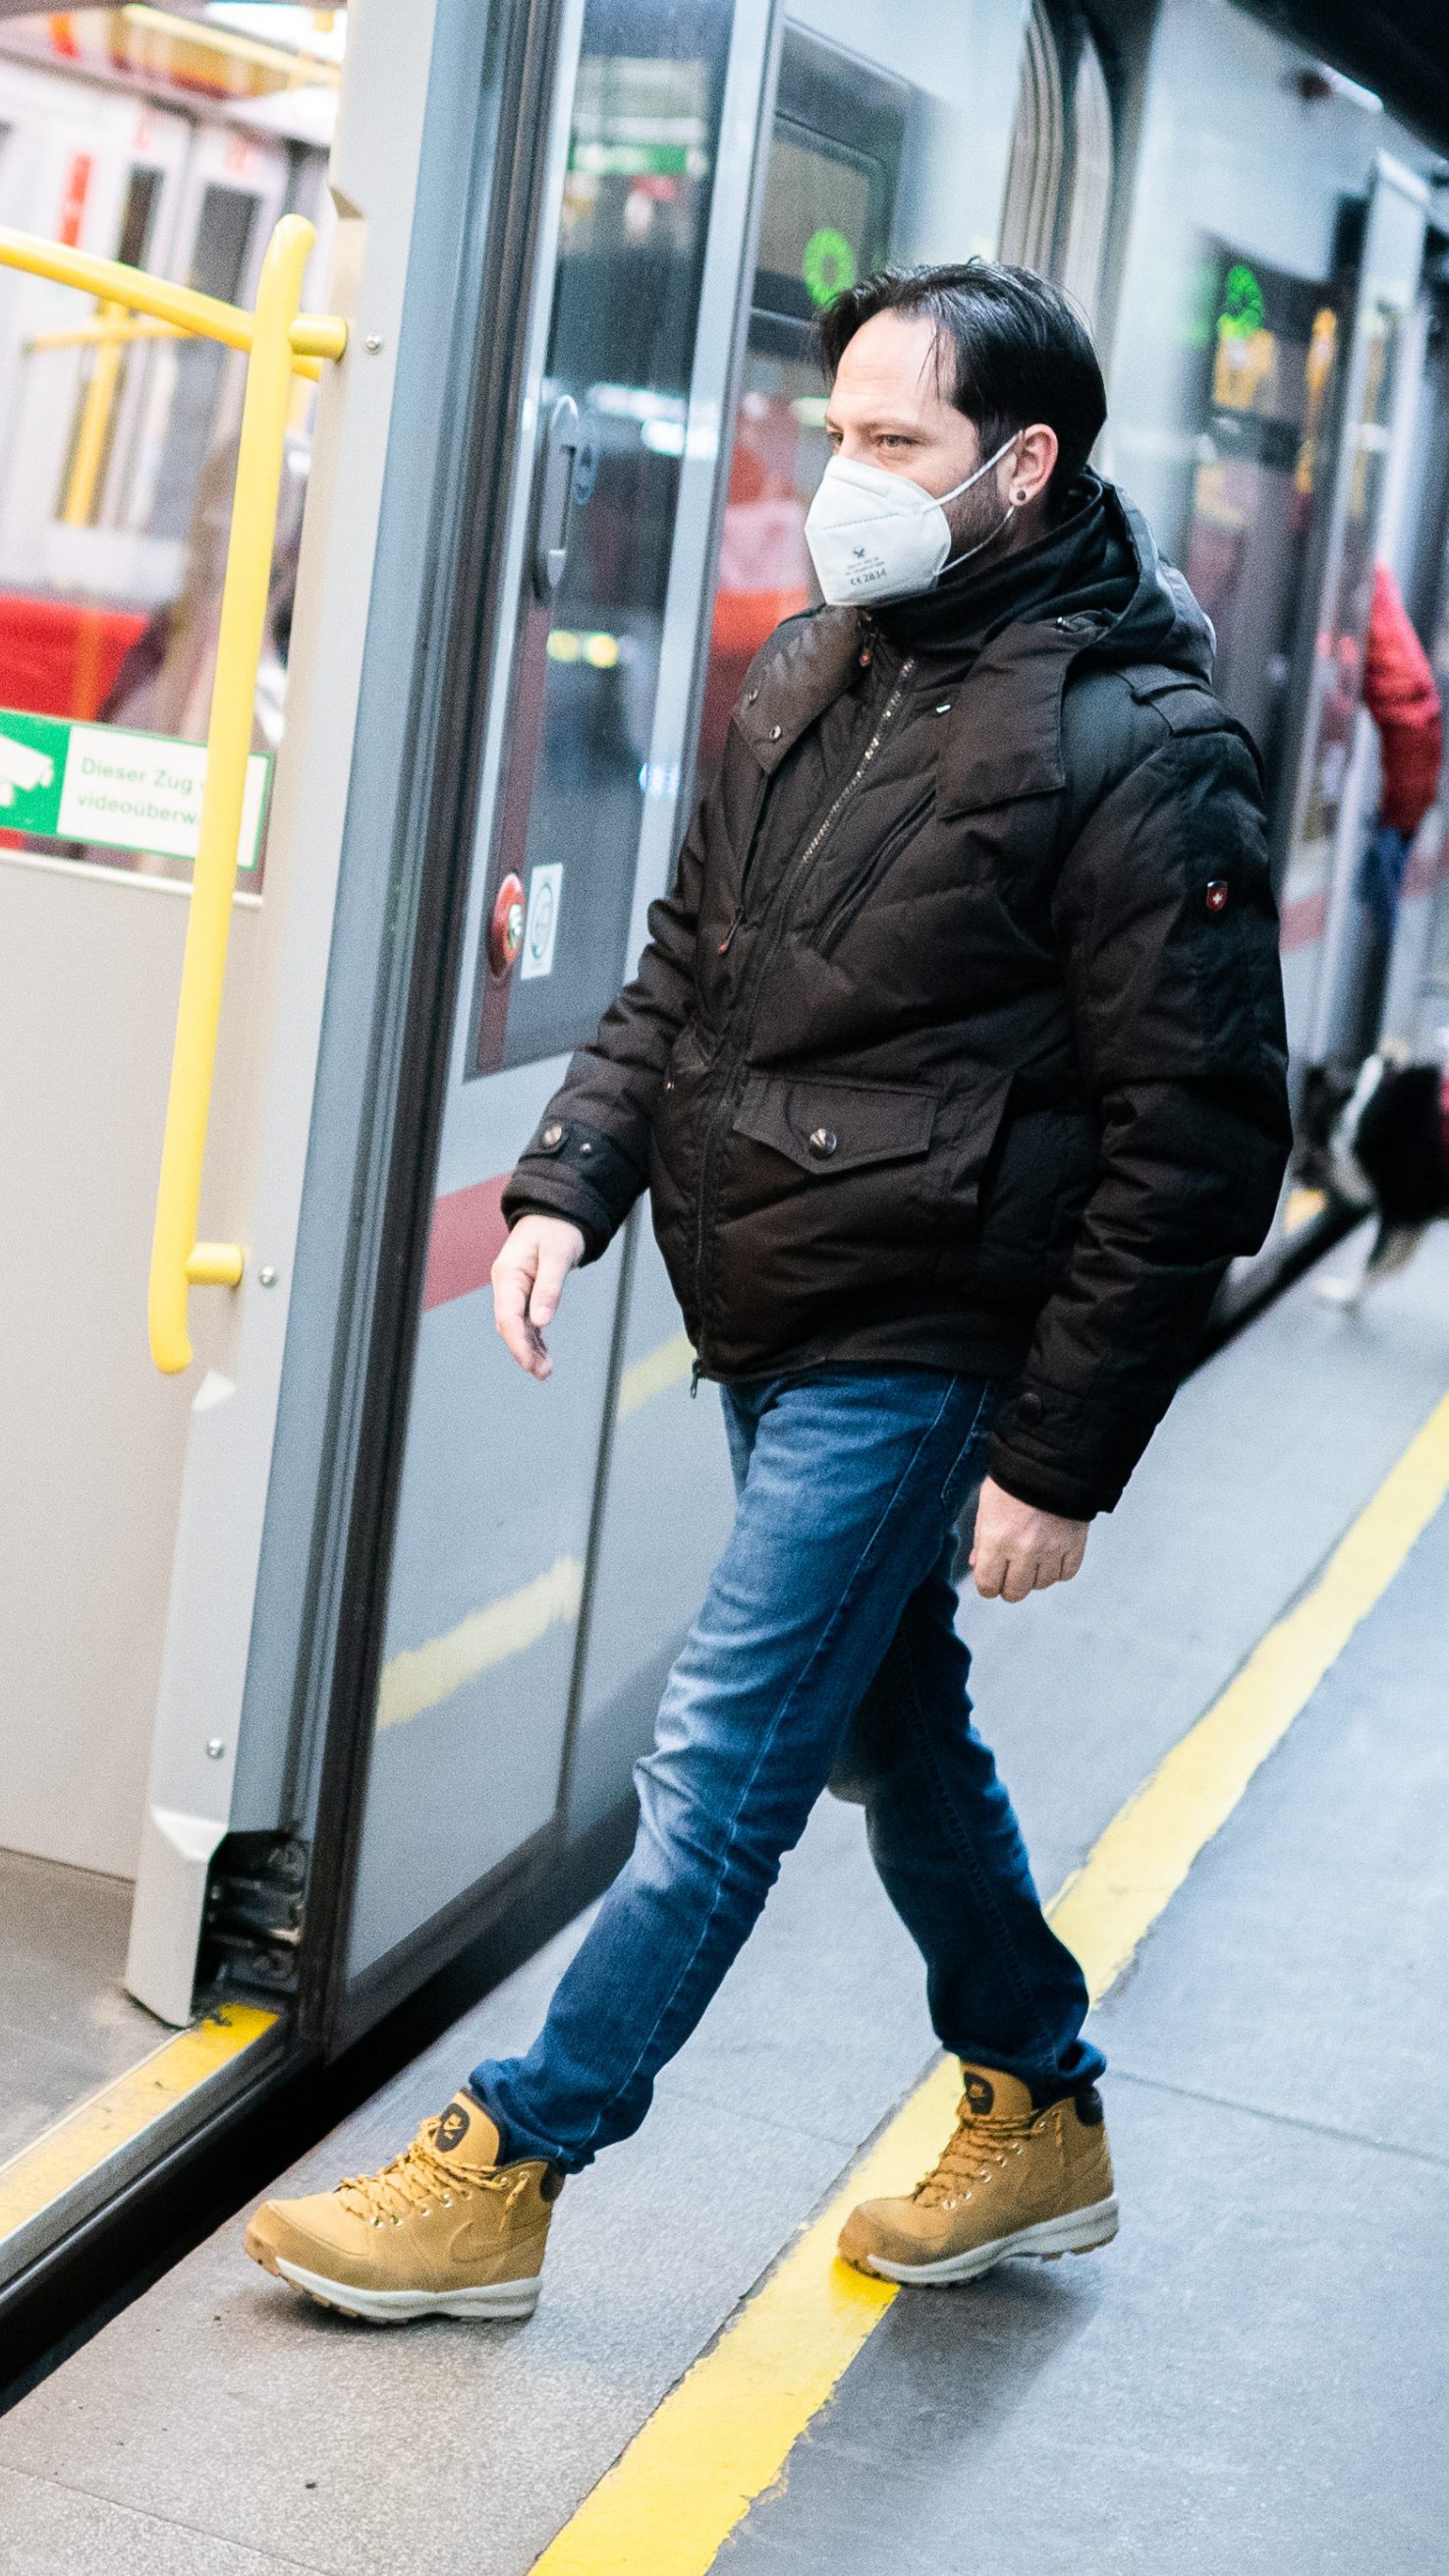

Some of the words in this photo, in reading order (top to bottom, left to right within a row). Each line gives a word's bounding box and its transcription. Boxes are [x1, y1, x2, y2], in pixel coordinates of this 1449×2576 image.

[82, 756, 146, 783] Dieser
[154, 769, 194, 797] Zug
[78, 792, 200, 826] videoüberw
